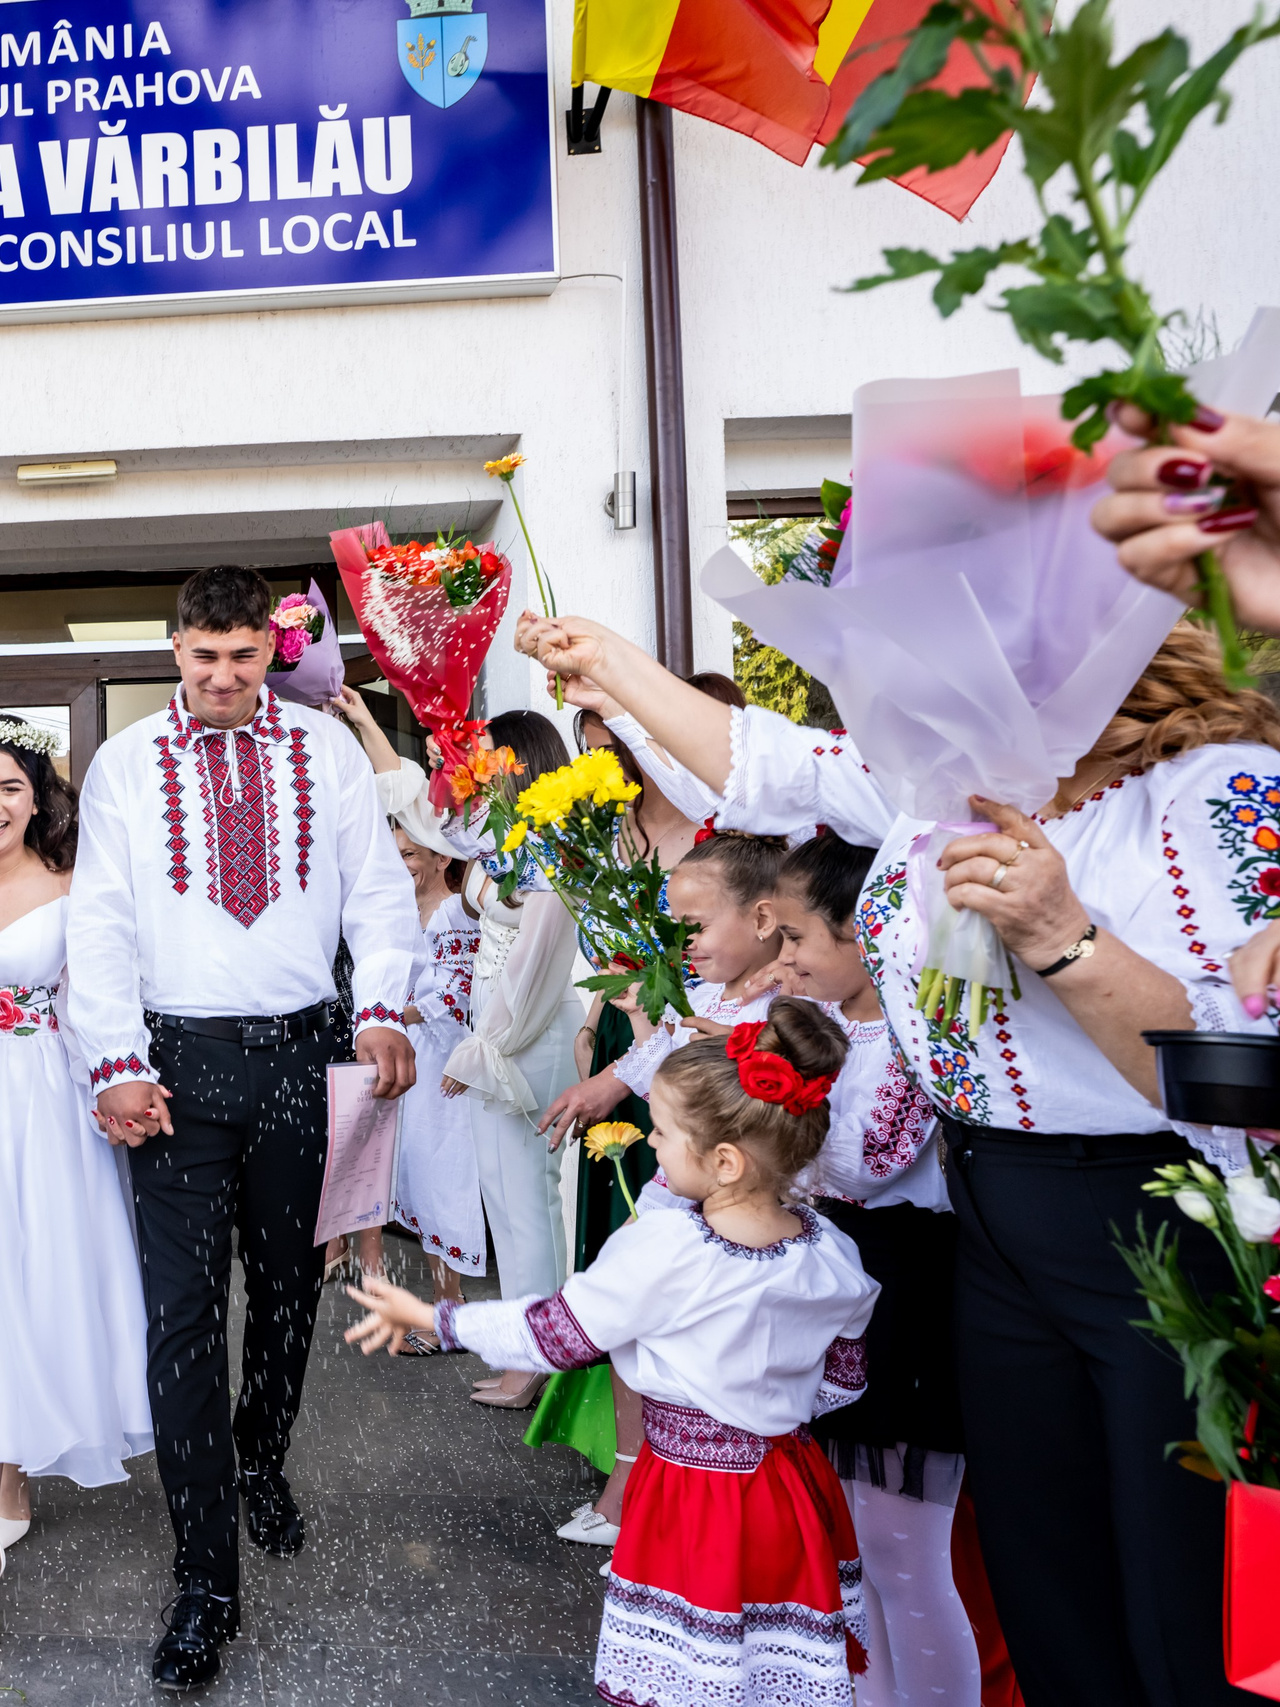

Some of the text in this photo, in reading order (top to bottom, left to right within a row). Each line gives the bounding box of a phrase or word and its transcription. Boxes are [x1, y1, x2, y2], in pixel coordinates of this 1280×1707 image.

[48, 65, 263, 115] PRAHOVA
[39, 103, 413, 216] VĂRBILĂU
[258, 210, 417, 257] LOCAL
